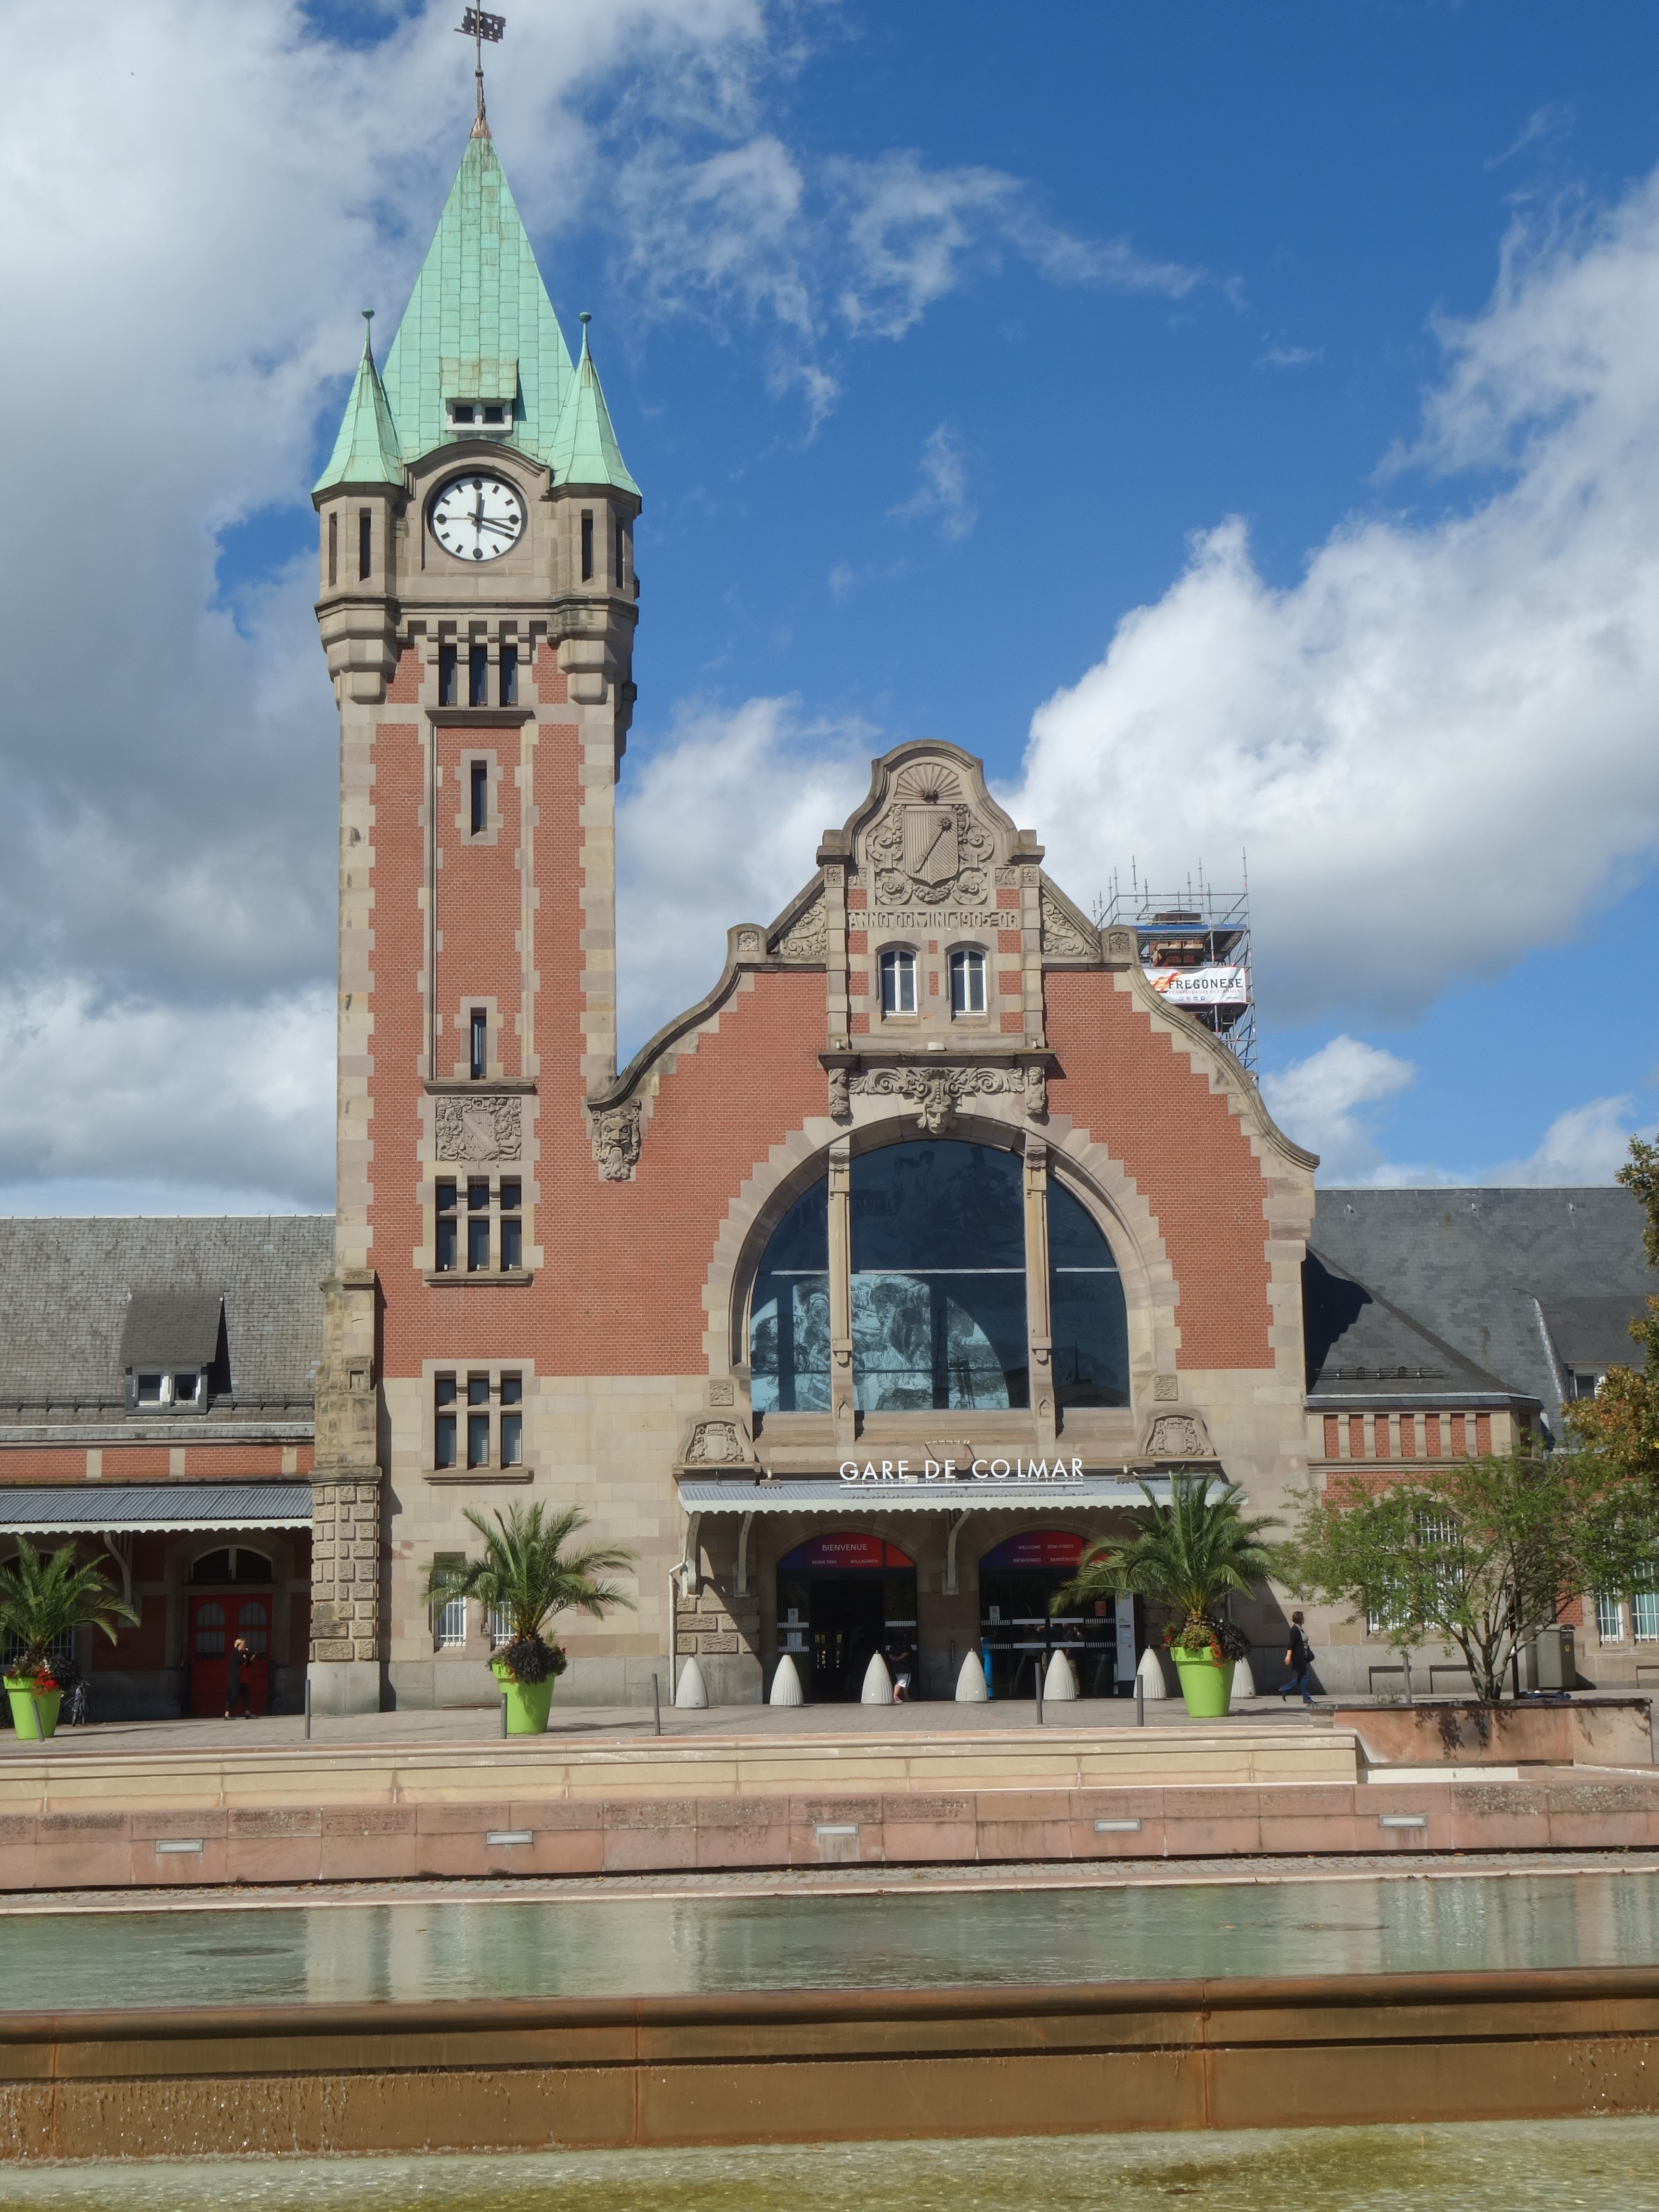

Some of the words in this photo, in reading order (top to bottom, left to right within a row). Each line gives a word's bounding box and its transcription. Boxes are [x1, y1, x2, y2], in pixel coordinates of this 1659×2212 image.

[849, 912, 889, 928] ANNO
[894, 912, 950, 928] DOMINI
[1168, 978, 1243, 989] FREGONESE
[839, 1460, 909, 1481] GARE
[925, 1459, 956, 1479] DE
[972, 1458, 1084, 1479] COLMAR
